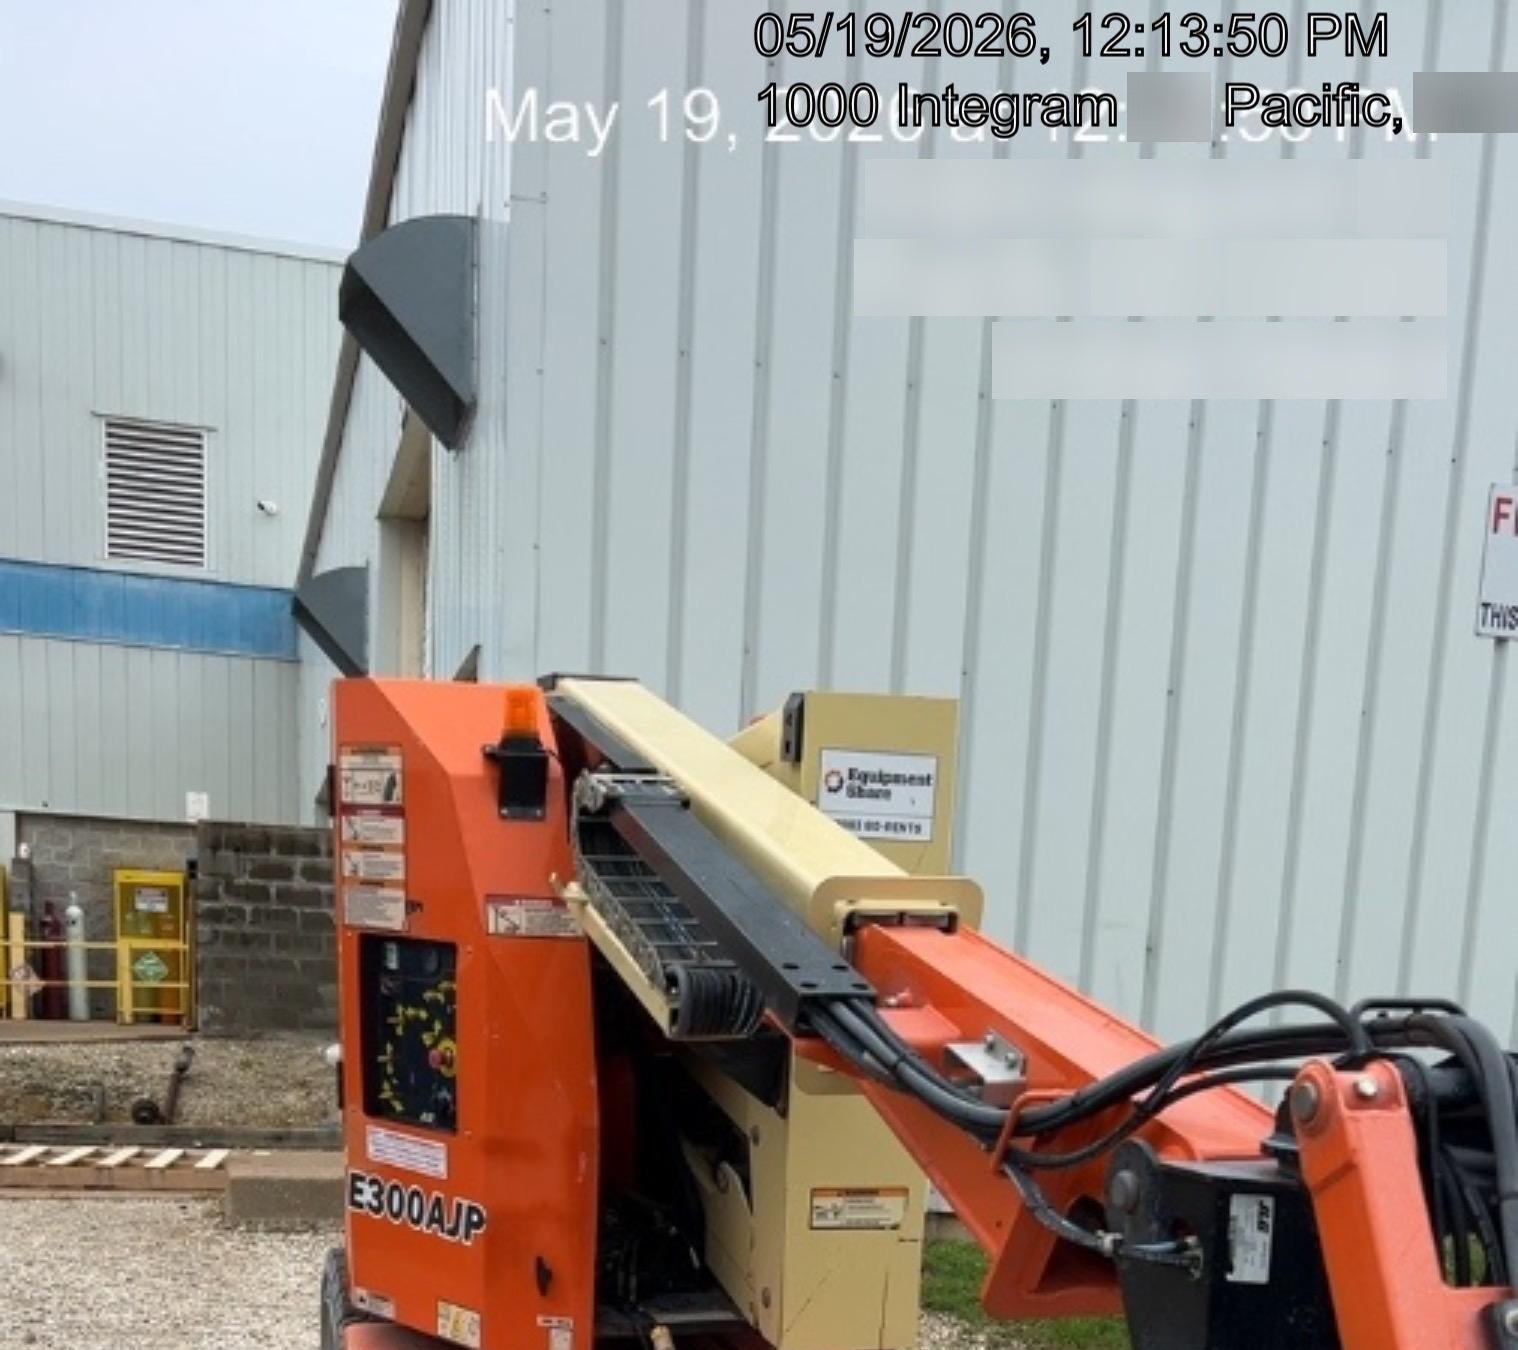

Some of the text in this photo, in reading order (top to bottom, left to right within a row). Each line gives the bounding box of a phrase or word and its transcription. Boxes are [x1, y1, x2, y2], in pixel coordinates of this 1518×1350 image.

[1481, 602, 1518, 631] THIS
[847, 768, 931, 788] Equipment
[846, 781, 892, 801] Share
[348, 1170, 486, 1244] E300AJP
